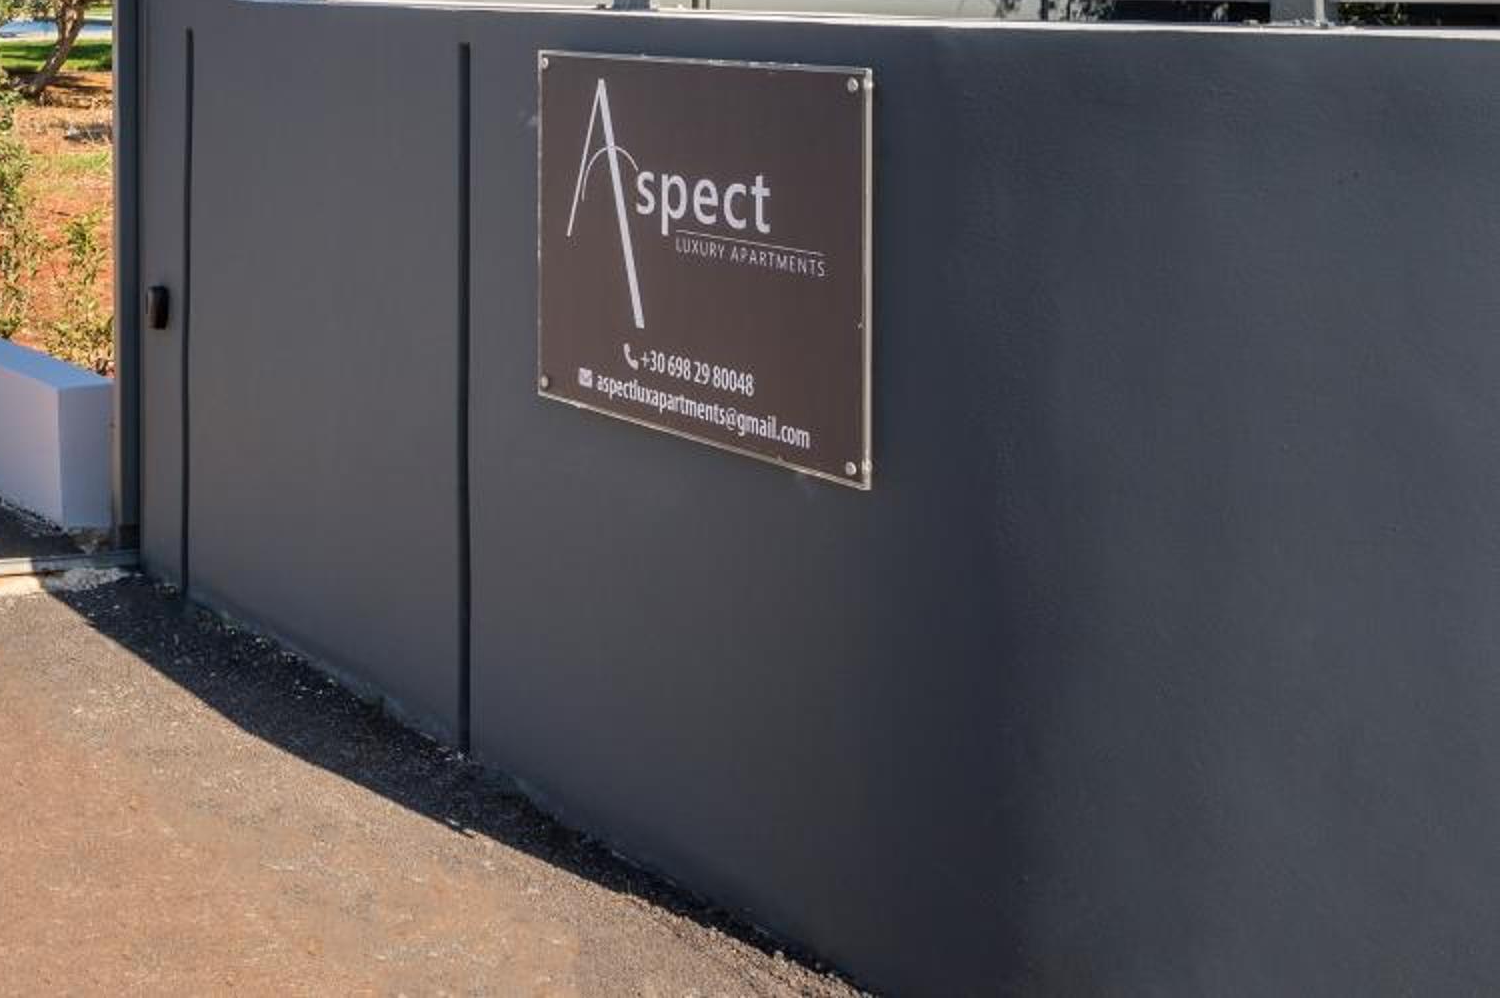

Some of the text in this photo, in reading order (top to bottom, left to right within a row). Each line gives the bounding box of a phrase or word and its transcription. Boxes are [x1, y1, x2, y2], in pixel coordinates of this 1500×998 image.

[566, 78, 772, 330] Aspect
[675, 236, 826, 278] LUXURY APARTMENTS
[640, 350, 755, 397] +30 698 29 80048
[596, 374, 811, 450] aspectluxapartments@gmail.com
